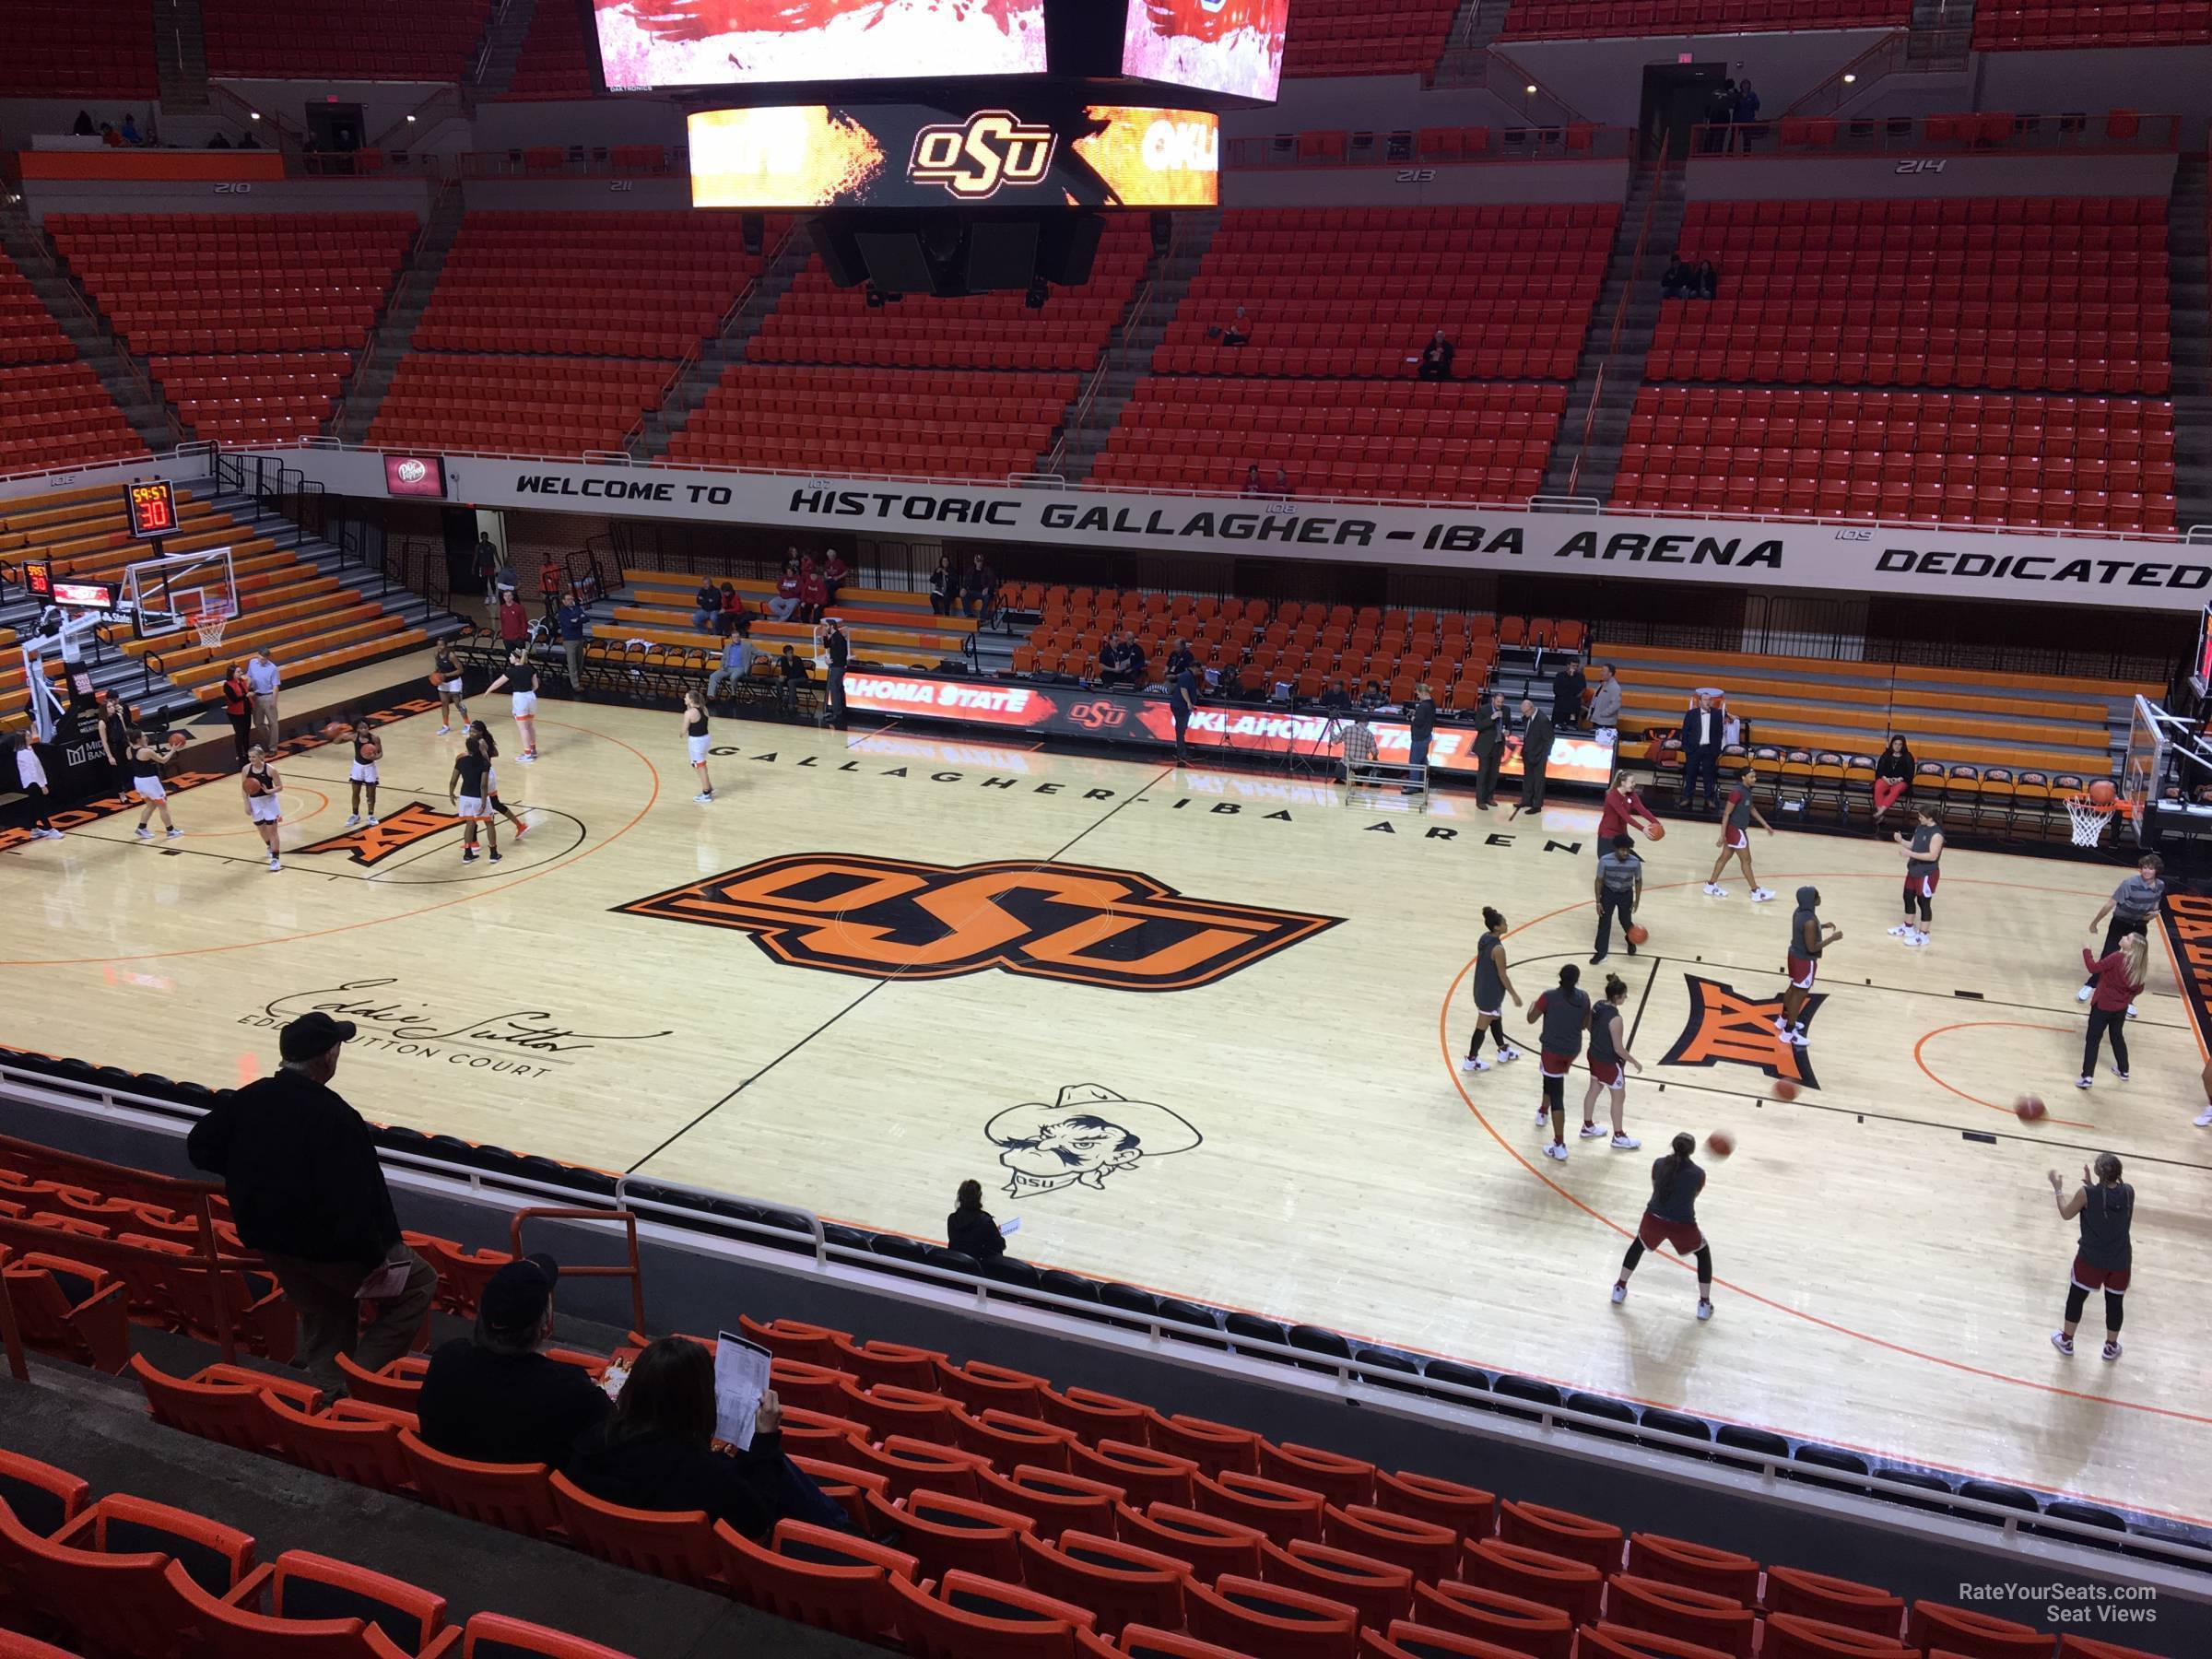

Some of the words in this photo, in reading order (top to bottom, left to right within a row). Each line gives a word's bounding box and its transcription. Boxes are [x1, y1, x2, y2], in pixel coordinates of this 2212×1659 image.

[909, 108, 1055, 196] OSU
[1895, 159, 1947, 174] 214
[1395, 169, 1437, 182] 213
[214, 182, 252, 194] 210
[610, 180, 632, 192] 211
[133, 486, 167, 502] 59:57
[141, 501, 167, 528] 30
[1265, 504, 1298, 514] 108
[516, 475, 676, 501] WELCOME
[687, 485, 732, 505] TO
[789, 488, 1021, 525] HISTORIC
[1554, 531, 1783, 569] ARENA
[1875, 548, 2212, 590] DEDICATED
[1834, 529, 1874, 543] 109
[31, 577, 47, 591] 30
[842, 677, 933, 704] AHOMA
[937, 684, 1030, 712] STATE
[1069, 700, 1127, 729] OSU
[1171, 711, 1342, 743] OKLAHOM
[88, 750, 106, 761] BAN
[1364, 820, 1645, 863] AREN
[631, 857, 1327, 986] OSU
[238, 1014, 291, 1031] EDD
[347, 1033, 441, 1060] UTTON
[449, 1053, 553, 1079] COURT
[1016, 1174, 1054, 1188] OSU
